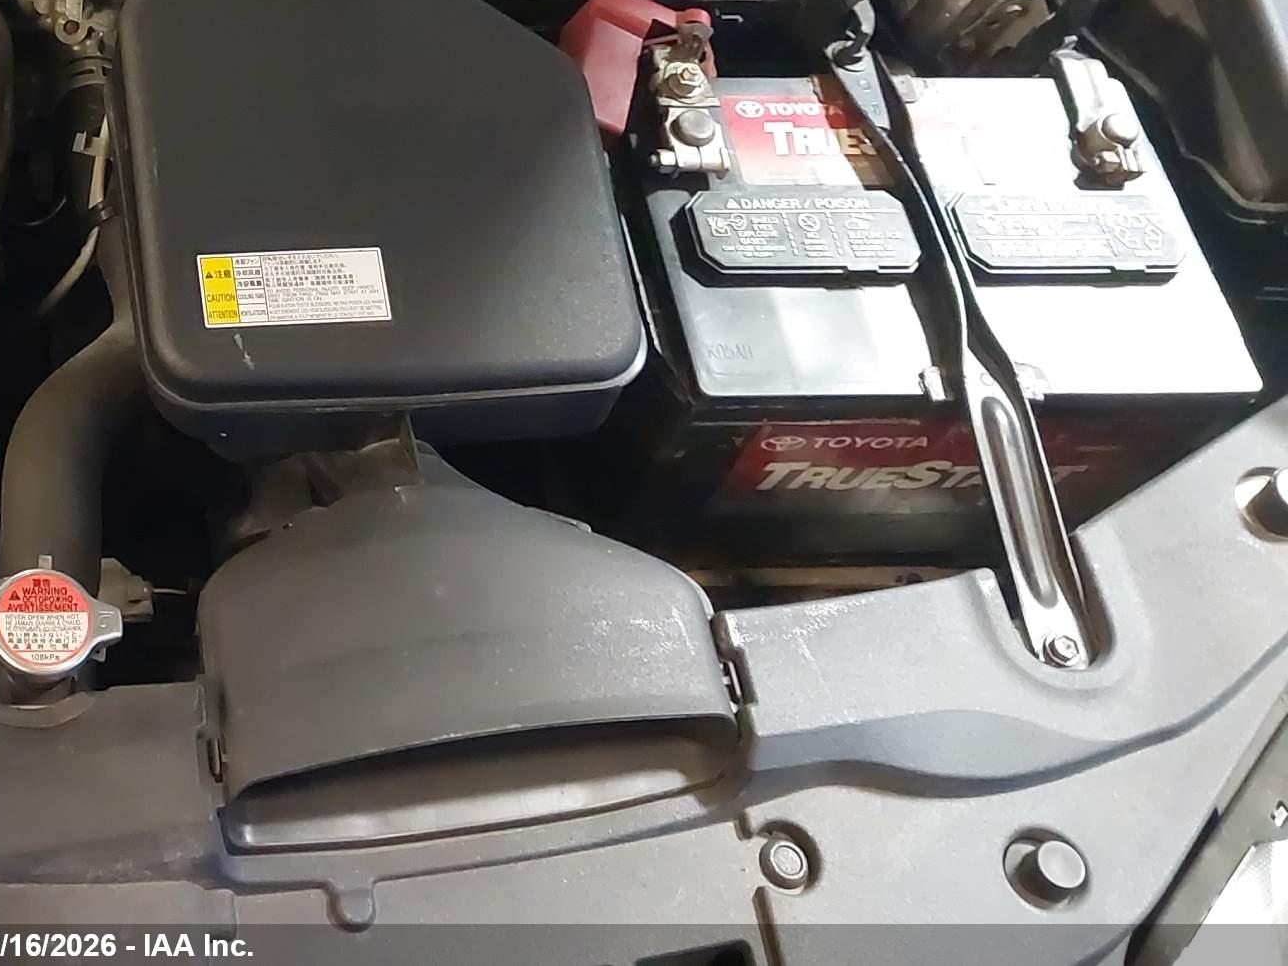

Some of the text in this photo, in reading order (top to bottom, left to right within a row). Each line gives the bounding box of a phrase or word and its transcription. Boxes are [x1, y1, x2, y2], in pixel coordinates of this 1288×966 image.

[740, 198, 801, 209] DANGER
[814, 198, 871, 209] POISON
[206, 293, 235, 302] CAUTION
[208, 309, 238, 319] ATTENTION
[813, 436, 928, 448] TOYOTA
[22, 587, 68, 595] WARNING
[7, 603, 79, 612] AVERTISSEMENT
